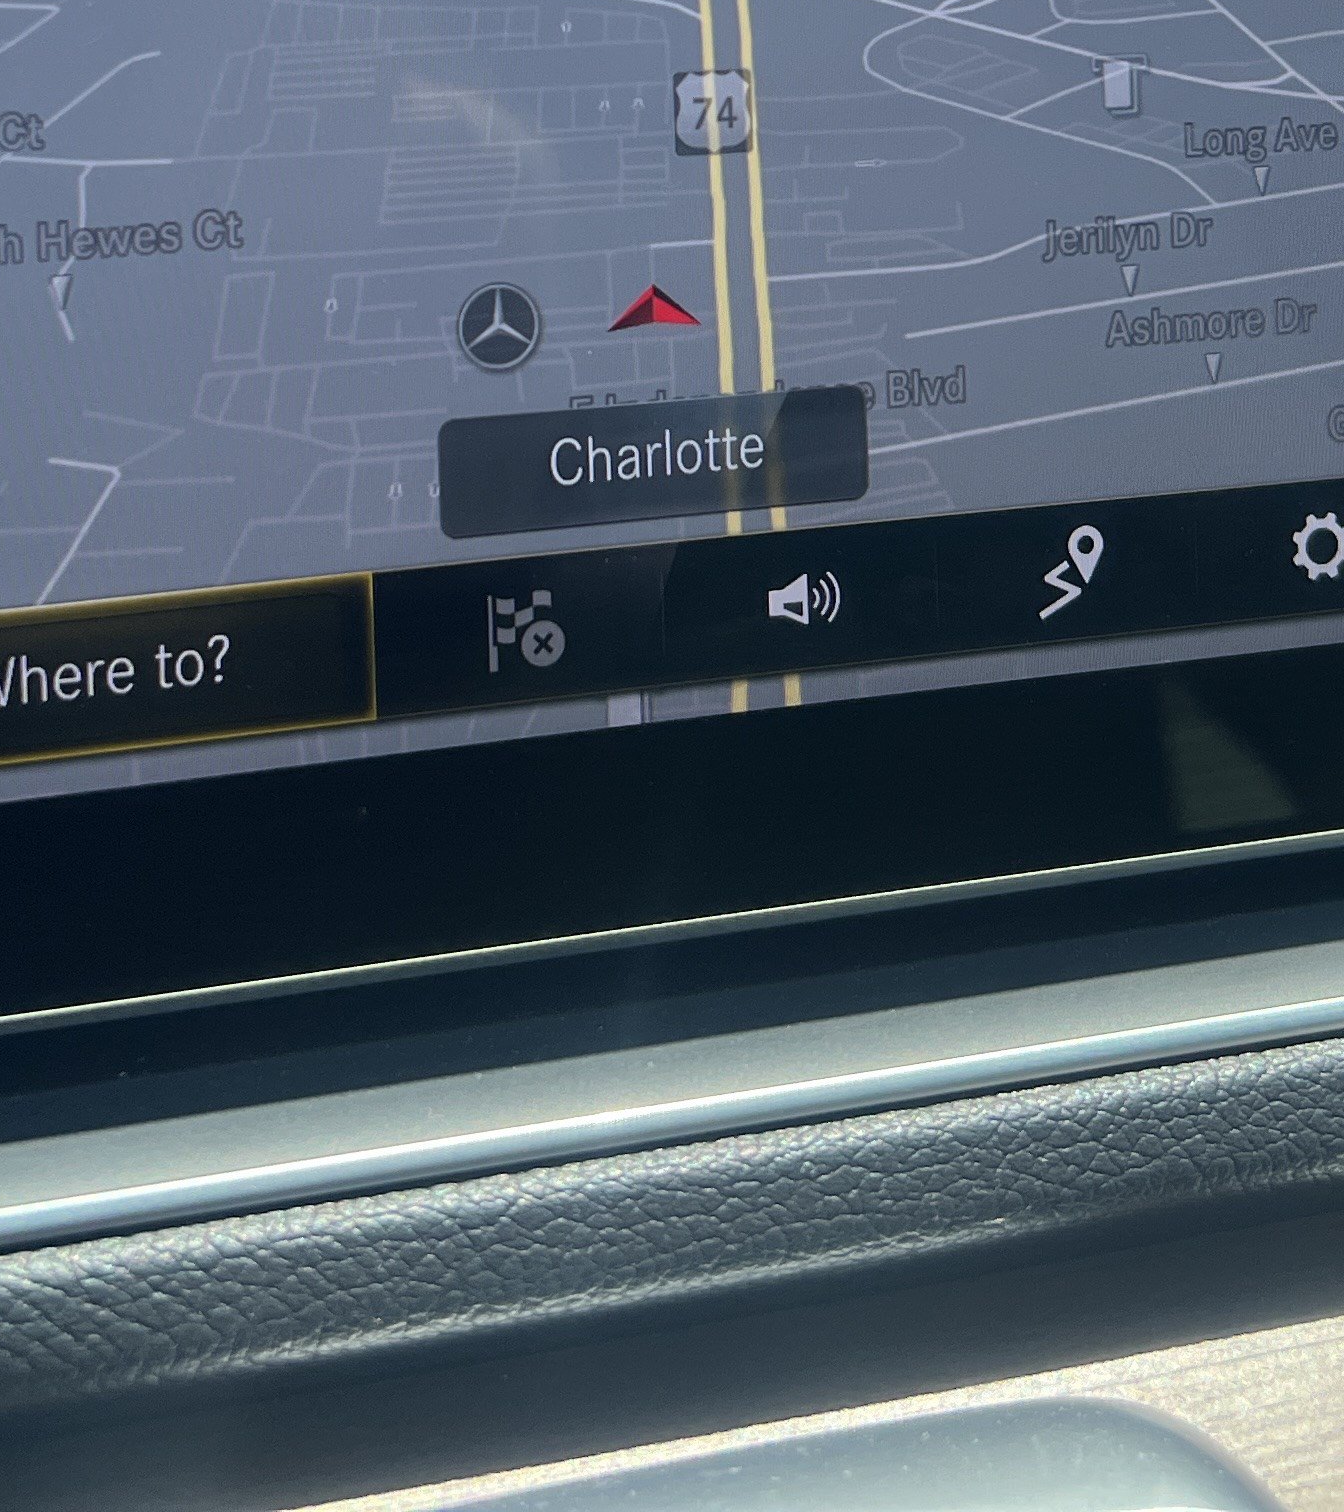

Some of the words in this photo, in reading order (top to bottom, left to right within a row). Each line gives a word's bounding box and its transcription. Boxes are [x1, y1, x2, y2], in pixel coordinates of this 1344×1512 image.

[693, 97, 738, 130] 74
[1183, 122, 1268, 160] Long
[1273, 117, 1339, 153] Ave
[36, 215, 182, 261] Hewes
[193, 209, 244, 250] Ct
[1042, 217, 1160, 262] Jerilyn
[1169, 211, 1214, 248] Dr
[1105, 305, 1265, 348] Ashmore
[1273, 297, 1317, 335] Dr
[886, 365, 967, 409] Blvd
[550, 427, 765, 486] Charlotte
[154, 634, 231, 690] to?
